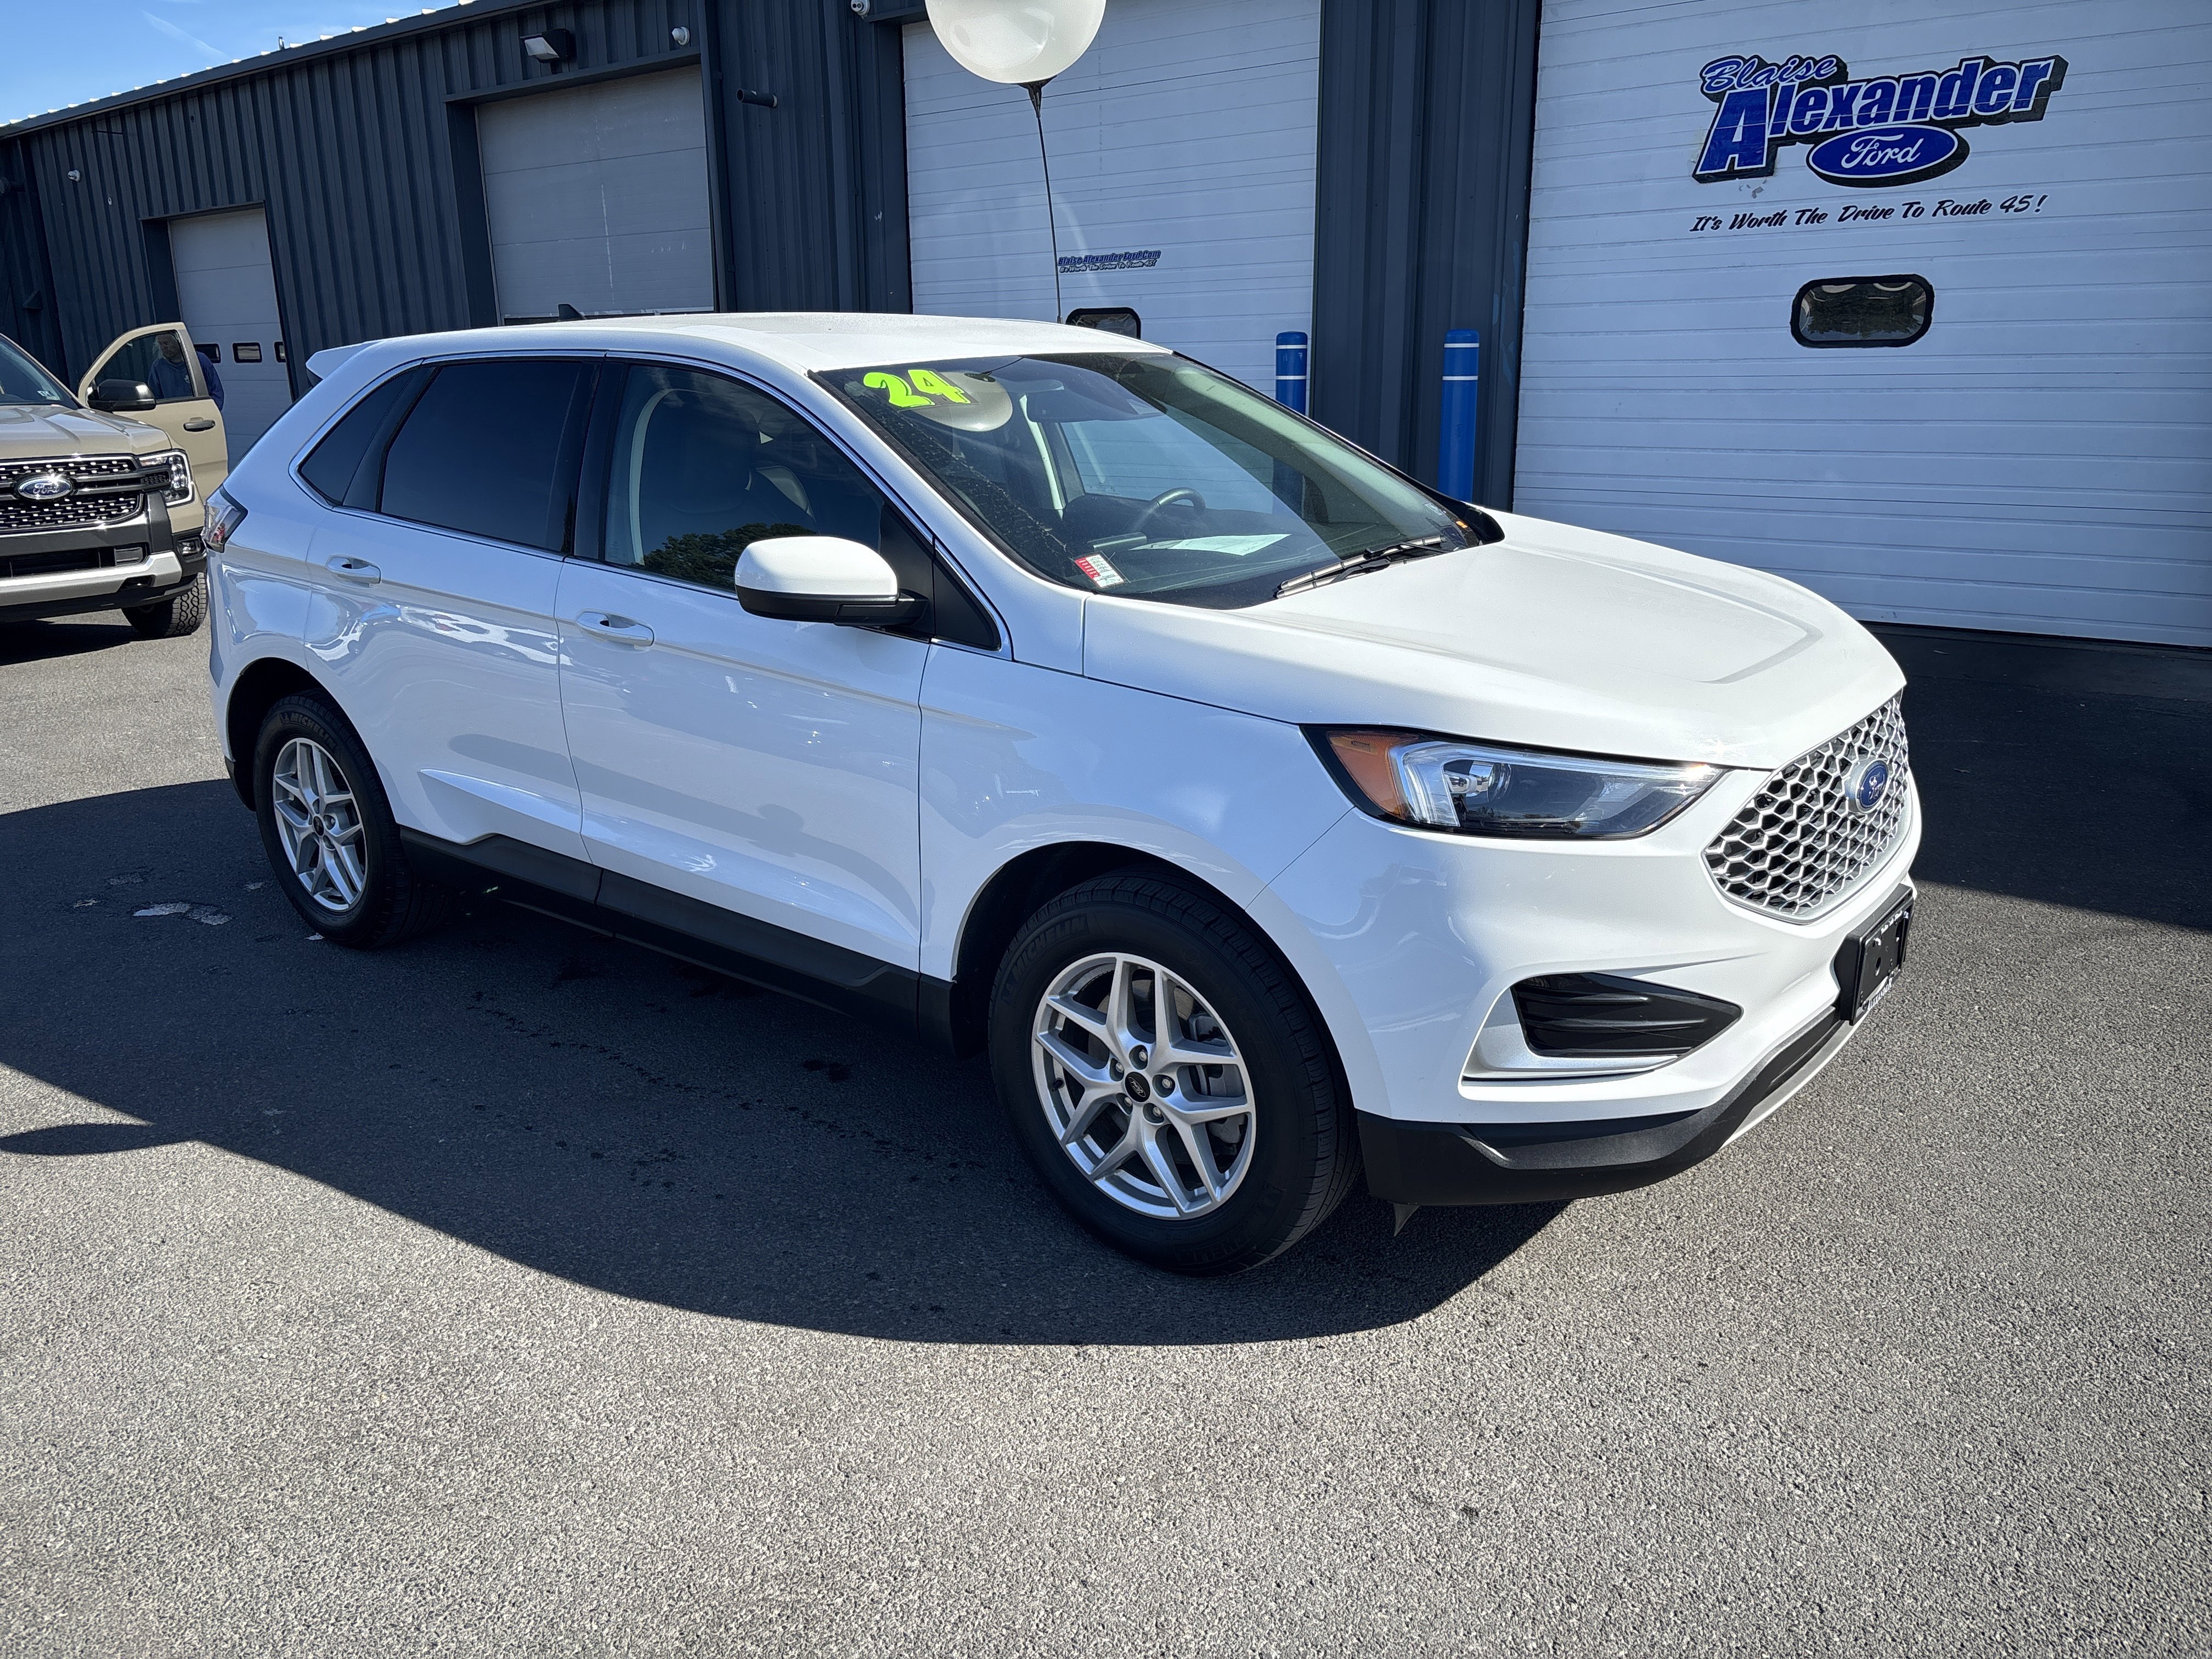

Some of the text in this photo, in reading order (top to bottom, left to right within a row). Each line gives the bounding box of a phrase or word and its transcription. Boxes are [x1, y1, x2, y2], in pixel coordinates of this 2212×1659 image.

[1702, 55, 1838, 94] Blaise
[1695, 57, 2057, 176] Alexander
[1840, 133, 1922, 170] Ford
[1689, 194, 2049, 232] It's Worth The Drive To Route 45!
[1082, 253, 1123, 264] Alexander
[863, 369, 972, 409] 24
